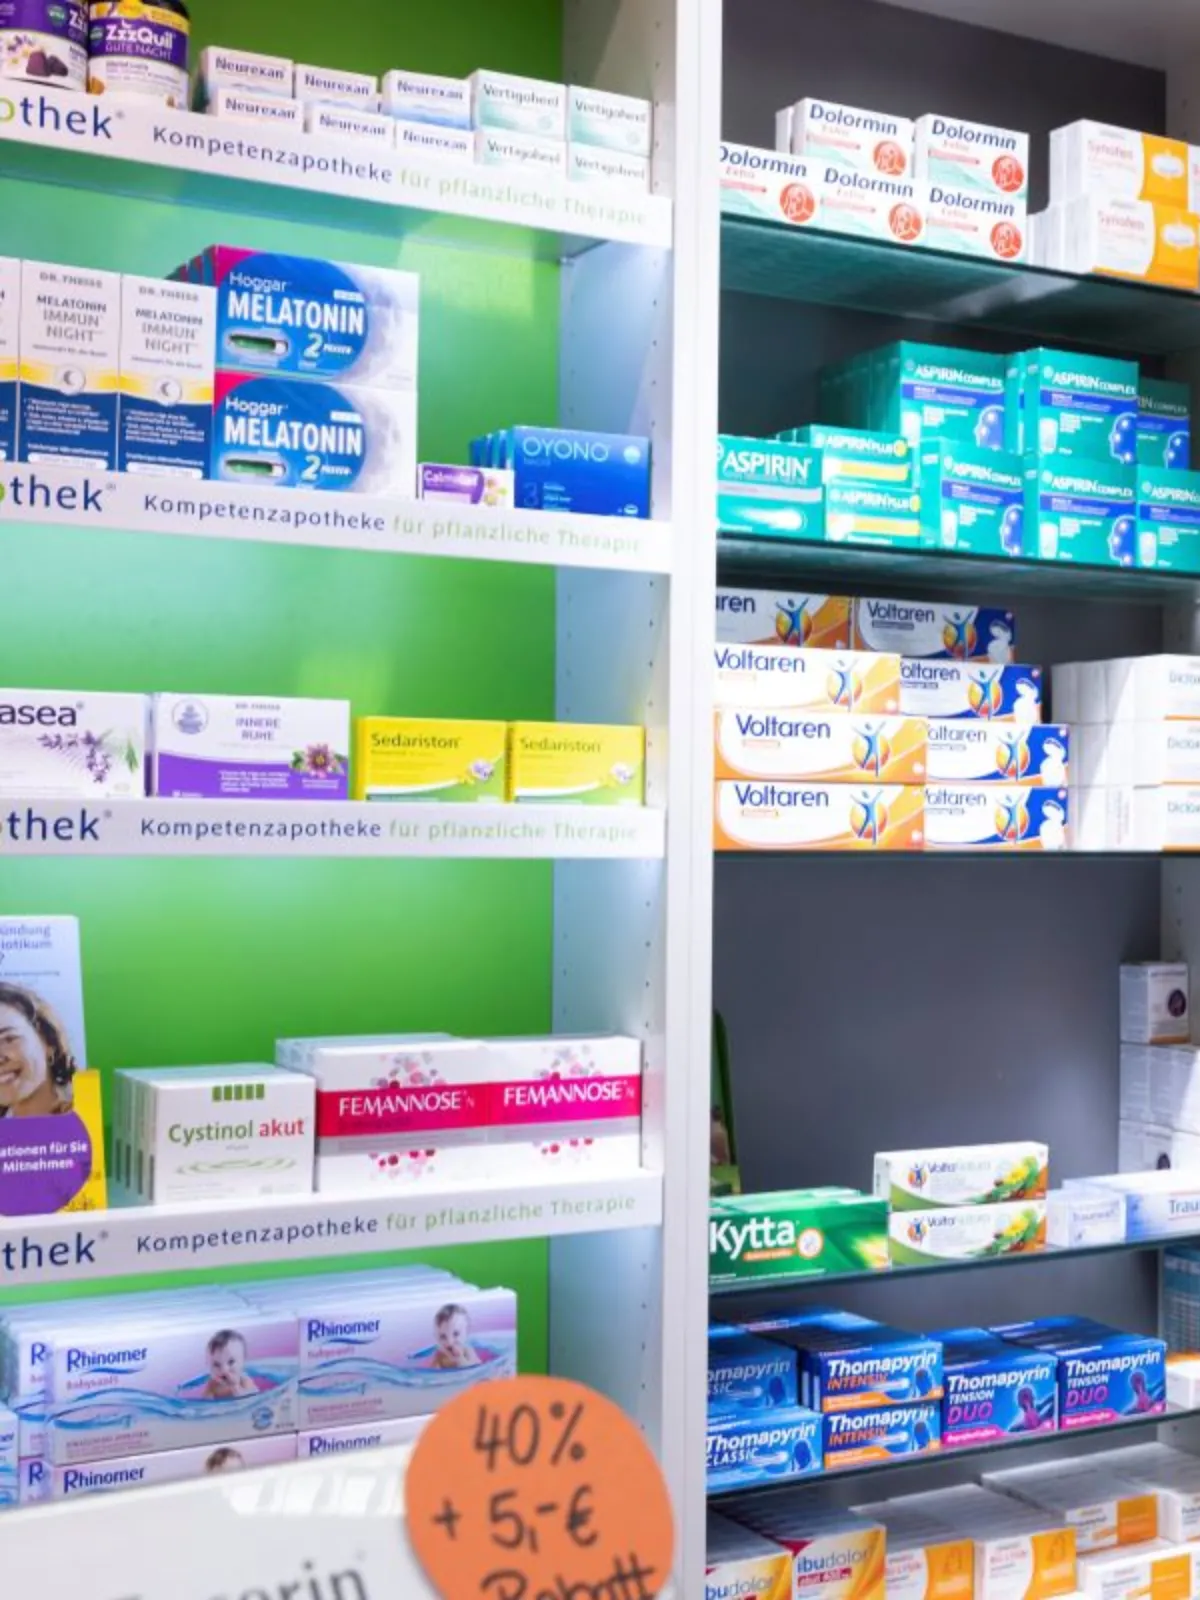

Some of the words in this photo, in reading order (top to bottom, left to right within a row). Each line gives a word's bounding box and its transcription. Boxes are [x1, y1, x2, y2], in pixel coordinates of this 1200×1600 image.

[105, 19, 174, 49] ZzzQuil
[215, 56, 285, 80] Neurexan
[304, 74, 370, 97] Neurexan
[397, 80, 463, 100] Neurexan
[483, 83, 560, 108] Vertigoheel
[225, 97, 296, 120] Neurexan
[574, 99, 647, 124] Vertigoheel
[809, 103, 897, 136] Dolormin
[319, 113, 386, 136] Neurexan
[931, 119, 1017, 150] Dolormin
[402, 129, 467, 151] Neurexan
[153, 125, 393, 184] Kompetenzapotheke
[400, 167, 430, 189] für
[438, 178, 556, 211] pflanzliche
[564, 197, 647, 227] Therapie
[823, 167, 914, 198] Dolormin
[929, 187, 1015, 217] Dolormin
[229, 271, 288, 293] Hoggar
[36, 294, 107, 313] MELATONIN
[228, 290, 364, 335] MELATONIN
[43, 309, 100, 327] IMMUN
[135, 307, 203, 326] MELATONIN
[46, 325, 95, 343] NIGHT
[142, 322, 196, 340] IMMUN
[145, 337, 191, 354] NIGHT
[303, 333, 323, 358] 2
[225, 396, 283, 416] Hoggar
[224, 415, 361, 456] MELATONIN
[522, 436, 610, 463] OYONO
[301, 455, 321, 480] 2
[722, 450, 813, 480] ASPIRIN
[0, 474, 103, 512] thek
[144, 494, 385, 531] Kompetenzapotheke
[393, 515, 423, 535] für
[432, 518, 550, 546] pflanzliche
[557, 528, 640, 555] Therapie
[866, 601, 936, 624] Voltaren
[715, 648, 807, 674] Voltaren
[735, 713, 831, 740] Voltaren
[370, 732, 459, 750] Sedariston
[520, 736, 600, 754] Sedariston
[734, 783, 829, 809] Voltaren
[141, 818, 381, 842] Kompetenzapotheke
[389, 820, 420, 838] für
[428, 821, 544, 842] pflanzliche
[554, 822, 638, 842] Therapie
[339, 1091, 462, 1118] FEMANNOSE
[504, 1081, 622, 1107] FEMANNOSE
[168, 1120, 254, 1147] Cystinol
[259, 1117, 304, 1138] akut
[49, 1141, 69, 1155] für
[70, 1140, 88, 1153] Sie
[2, 1158, 74, 1174] Mitnehmen
[137, 1216, 378, 1254] Kompetenzapotheke
[386, 1212, 416, 1232] für
[425, 1204, 543, 1232] pflanzliche
[551, 1195, 636, 1217] Therapie
[710, 1216, 796, 1261] Kytta
[308, 1319, 381, 1343] Rhinomer
[67, 1347, 148, 1373] Rhinomer
[828, 1351, 937, 1377] Thomapyrin
[1066, 1350, 1161, 1377] Thomapyrin
[948, 1365, 1050, 1392] Thomapyrin
[1066, 1374, 1109, 1390] TENSION
[948, 1389, 995, 1406] TENSION
[1064, 1386, 1109, 1408] DUO
[830, 1406, 935, 1434] Thomapyrin
[947, 1404, 994, 1426] DUO
[309, 1434, 381, 1456] Rhinomer
[473, 1400, 587, 1472] 40%
[706, 1423, 817, 1452] Thomapyrin
[64, 1467, 145, 1493] Rhinomer
[797, 1549, 873, 1574] ibudolor
